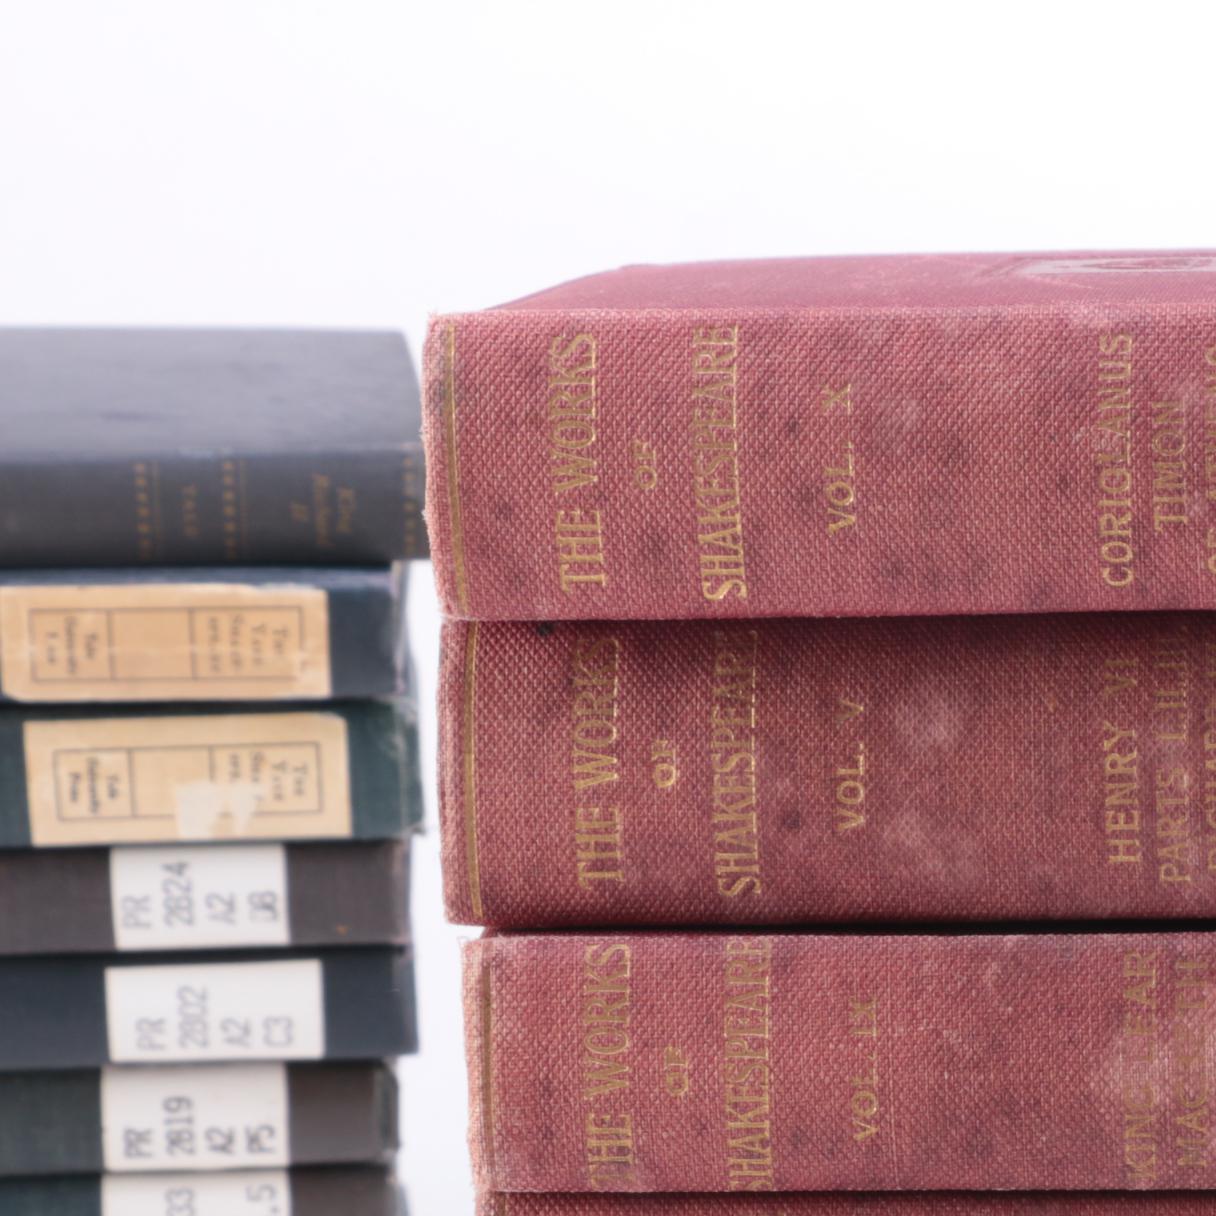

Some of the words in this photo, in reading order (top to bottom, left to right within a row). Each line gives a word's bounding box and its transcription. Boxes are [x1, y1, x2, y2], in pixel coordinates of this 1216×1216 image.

[549, 333, 597, 494] WORKS
[820, 382, 851, 416] X
[632, 439, 658, 490] OF
[691, 324, 748, 601] SHAKESPEARE
[821, 441, 856, 537] VOL.
[1096, 332, 1136, 588] CORIOLANUS
[1150, 397, 1188, 533] TIMON
[554, 511, 607, 593] THE
[570, 638, 621, 791] WORKS
[833, 696, 864, 726] V
[1104, 658, 1139, 694] VI
[650, 739, 681, 790] OF
[835, 741, 866, 834] VOL.
[1103, 719, 1142, 865] HENRY
[575, 805, 624, 891] THE
[1154, 766, 1191, 883] PARTS
[120, 894, 152, 930] PR
[161, 860, 194, 928] 2824
[135, 1017, 167, 1052] PR
[581, 943, 632, 1101] WORKS
[848, 995, 879, 1038] IX
[663, 1045, 689, 1097] OF
[849, 1051, 881, 1142] VOL.
[122, 1126, 154, 1159] PR
[162, 1095, 197, 1157] 2819
[203, 1124, 237, 1157] A2
[583, 1112, 634, 1189] THE
[1121, 1086, 1158, 1181] KING
